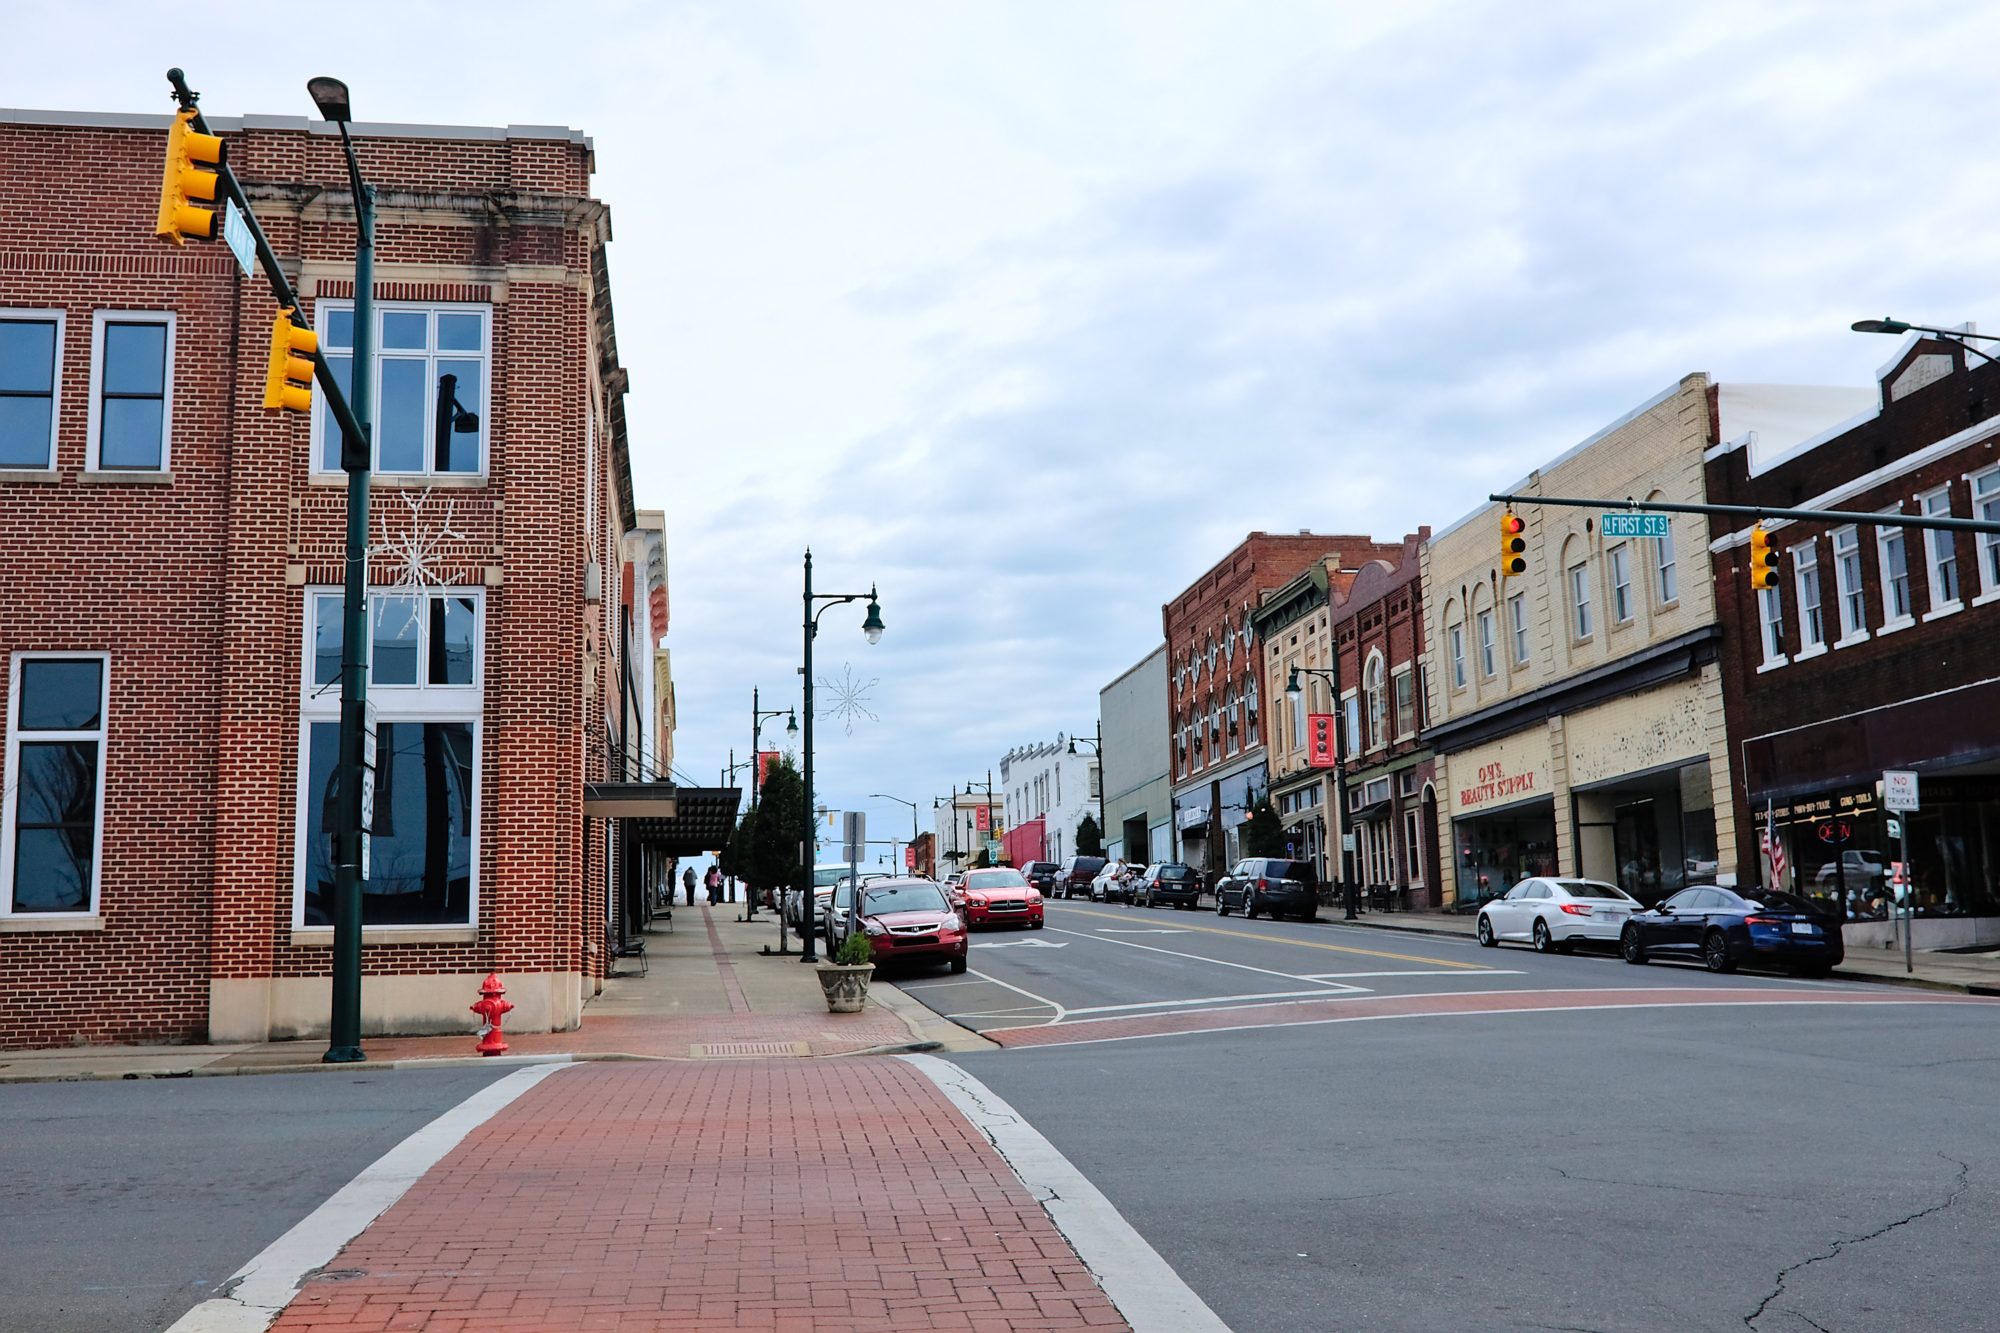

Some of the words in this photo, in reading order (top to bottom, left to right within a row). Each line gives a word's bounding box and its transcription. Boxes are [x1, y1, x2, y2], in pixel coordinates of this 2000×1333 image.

[1604, 517, 1610, 530] N
[1612, 517, 1640, 534] FIRST
[1644, 517, 1658, 534] ST.
[1659, 517, 1665, 530] S
[1894, 776, 1907, 786] NO
[1460, 783, 1495, 806] BEAUTY
[1497, 772, 1534, 797] SUPPLY
[1891, 787, 1911, 795] THRU
[363, 780, 373, 815] 52
[1888, 797, 1916, 806] TRUCKS
